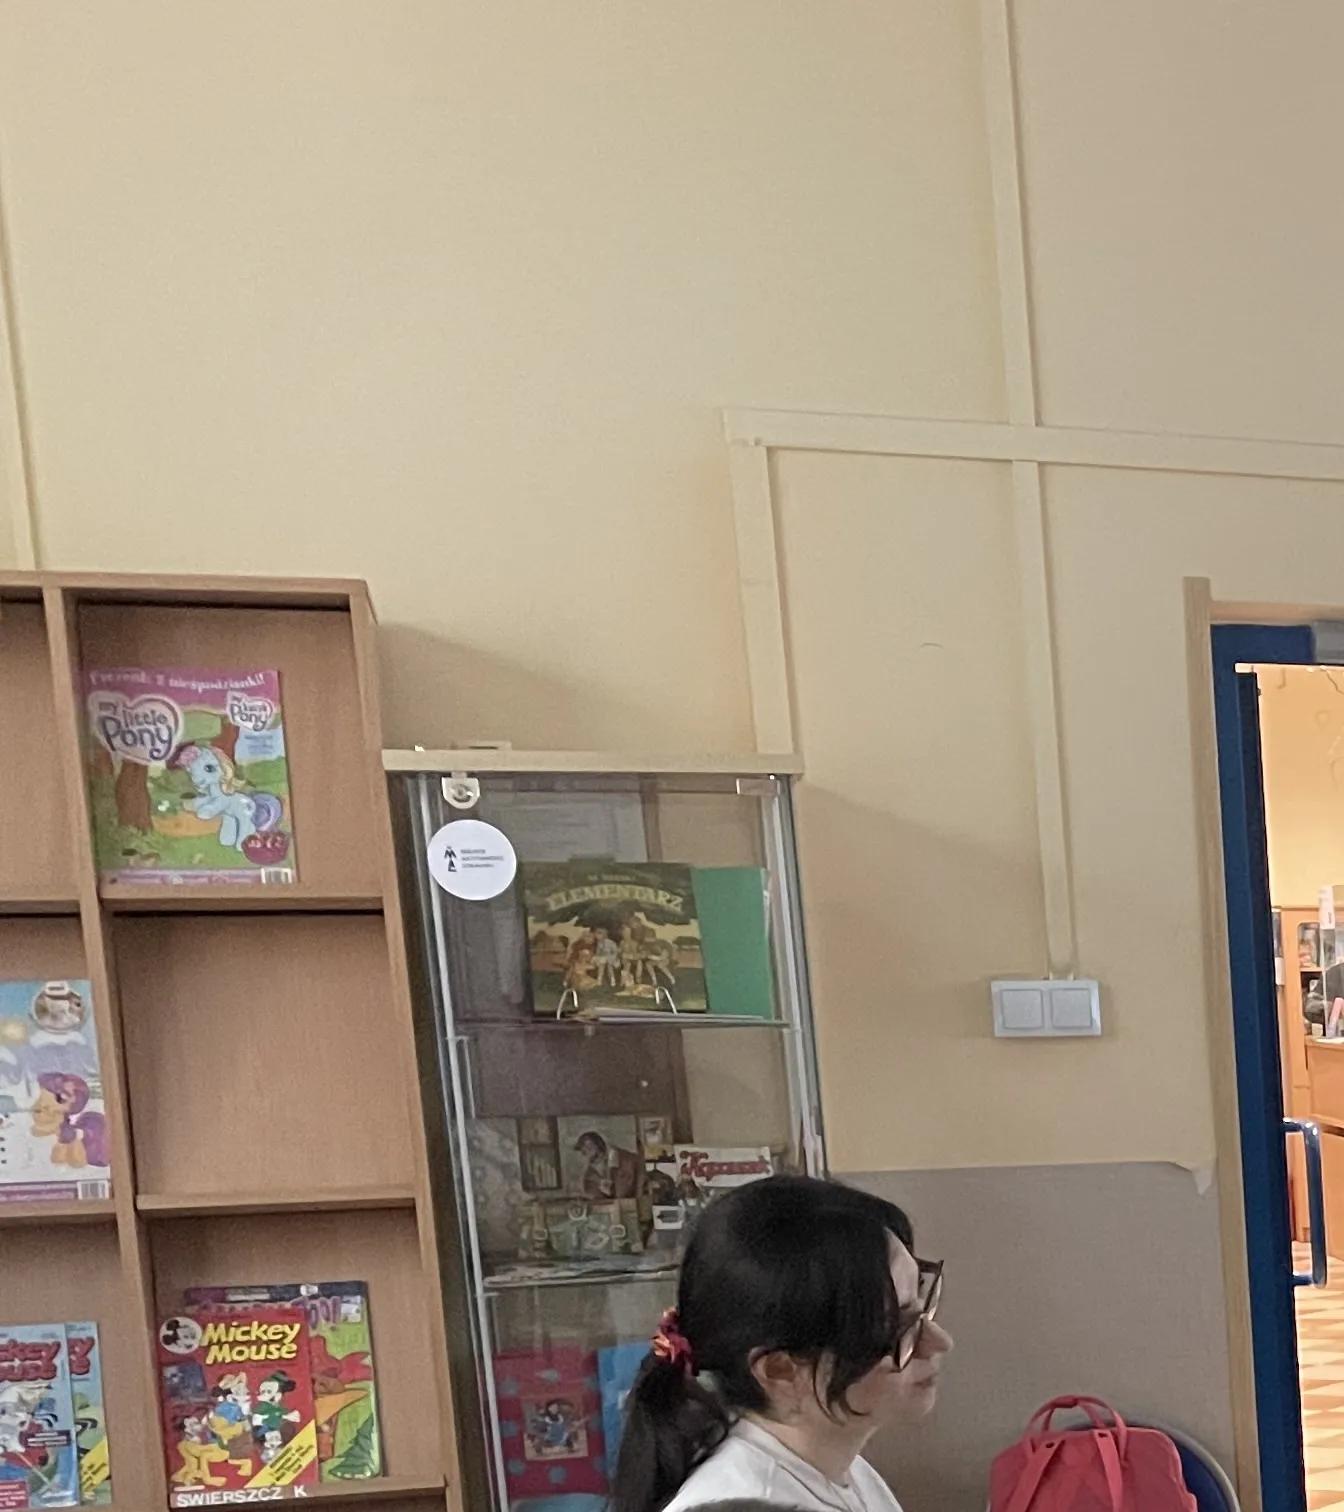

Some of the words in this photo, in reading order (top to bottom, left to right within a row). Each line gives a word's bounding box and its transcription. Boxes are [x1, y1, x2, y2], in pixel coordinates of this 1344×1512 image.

[100, 716, 173, 761] Pony
[203, 1321, 301, 1347] Mickey
[205, 1343, 297, 1365] Mouse
